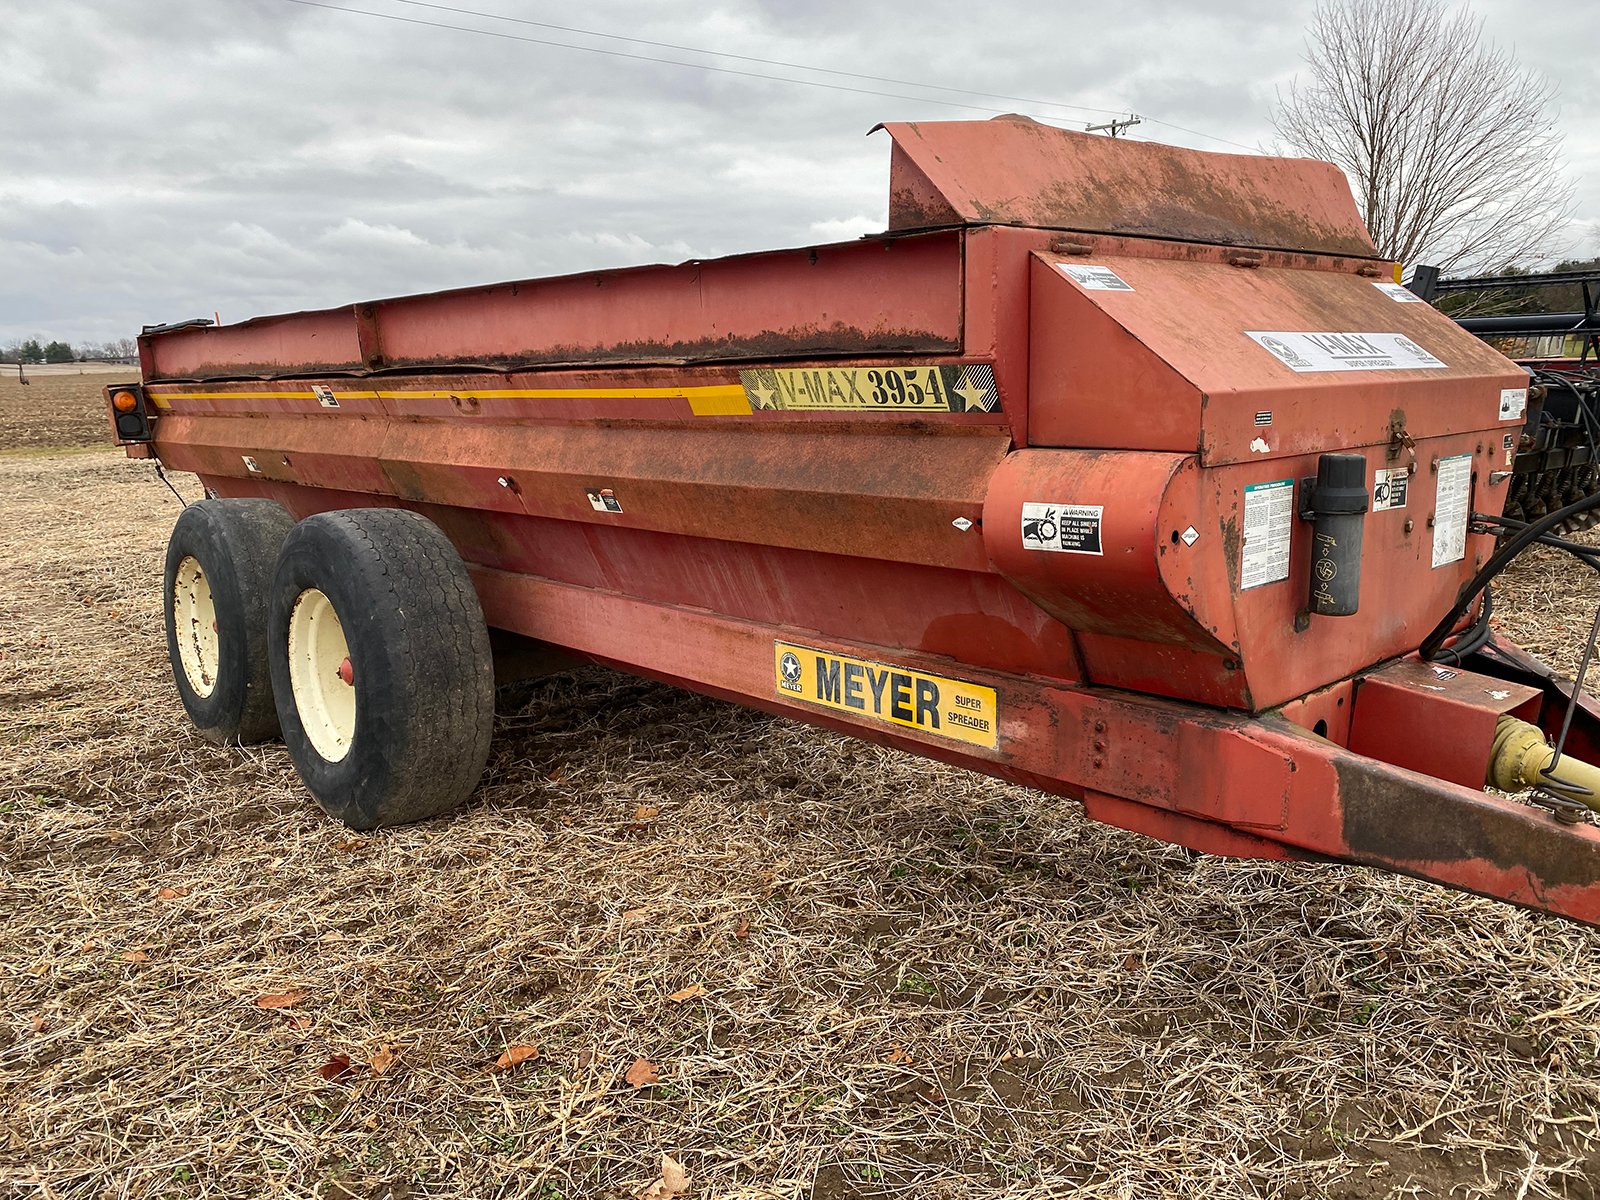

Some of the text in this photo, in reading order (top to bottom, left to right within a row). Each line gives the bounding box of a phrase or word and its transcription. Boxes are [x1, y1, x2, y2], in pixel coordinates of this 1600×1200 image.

[1301, 335, 1387, 354] V-MAX
[777, 369, 946, 405] V-MAX 3954
[1069, 509, 1099, 518] WARNING
[780, 680, 802, 693] MEYER
[815, 656, 941, 730] MEYER
[955, 694, 982, 710] SUPER
[947, 711, 990, 731] SPREADER
